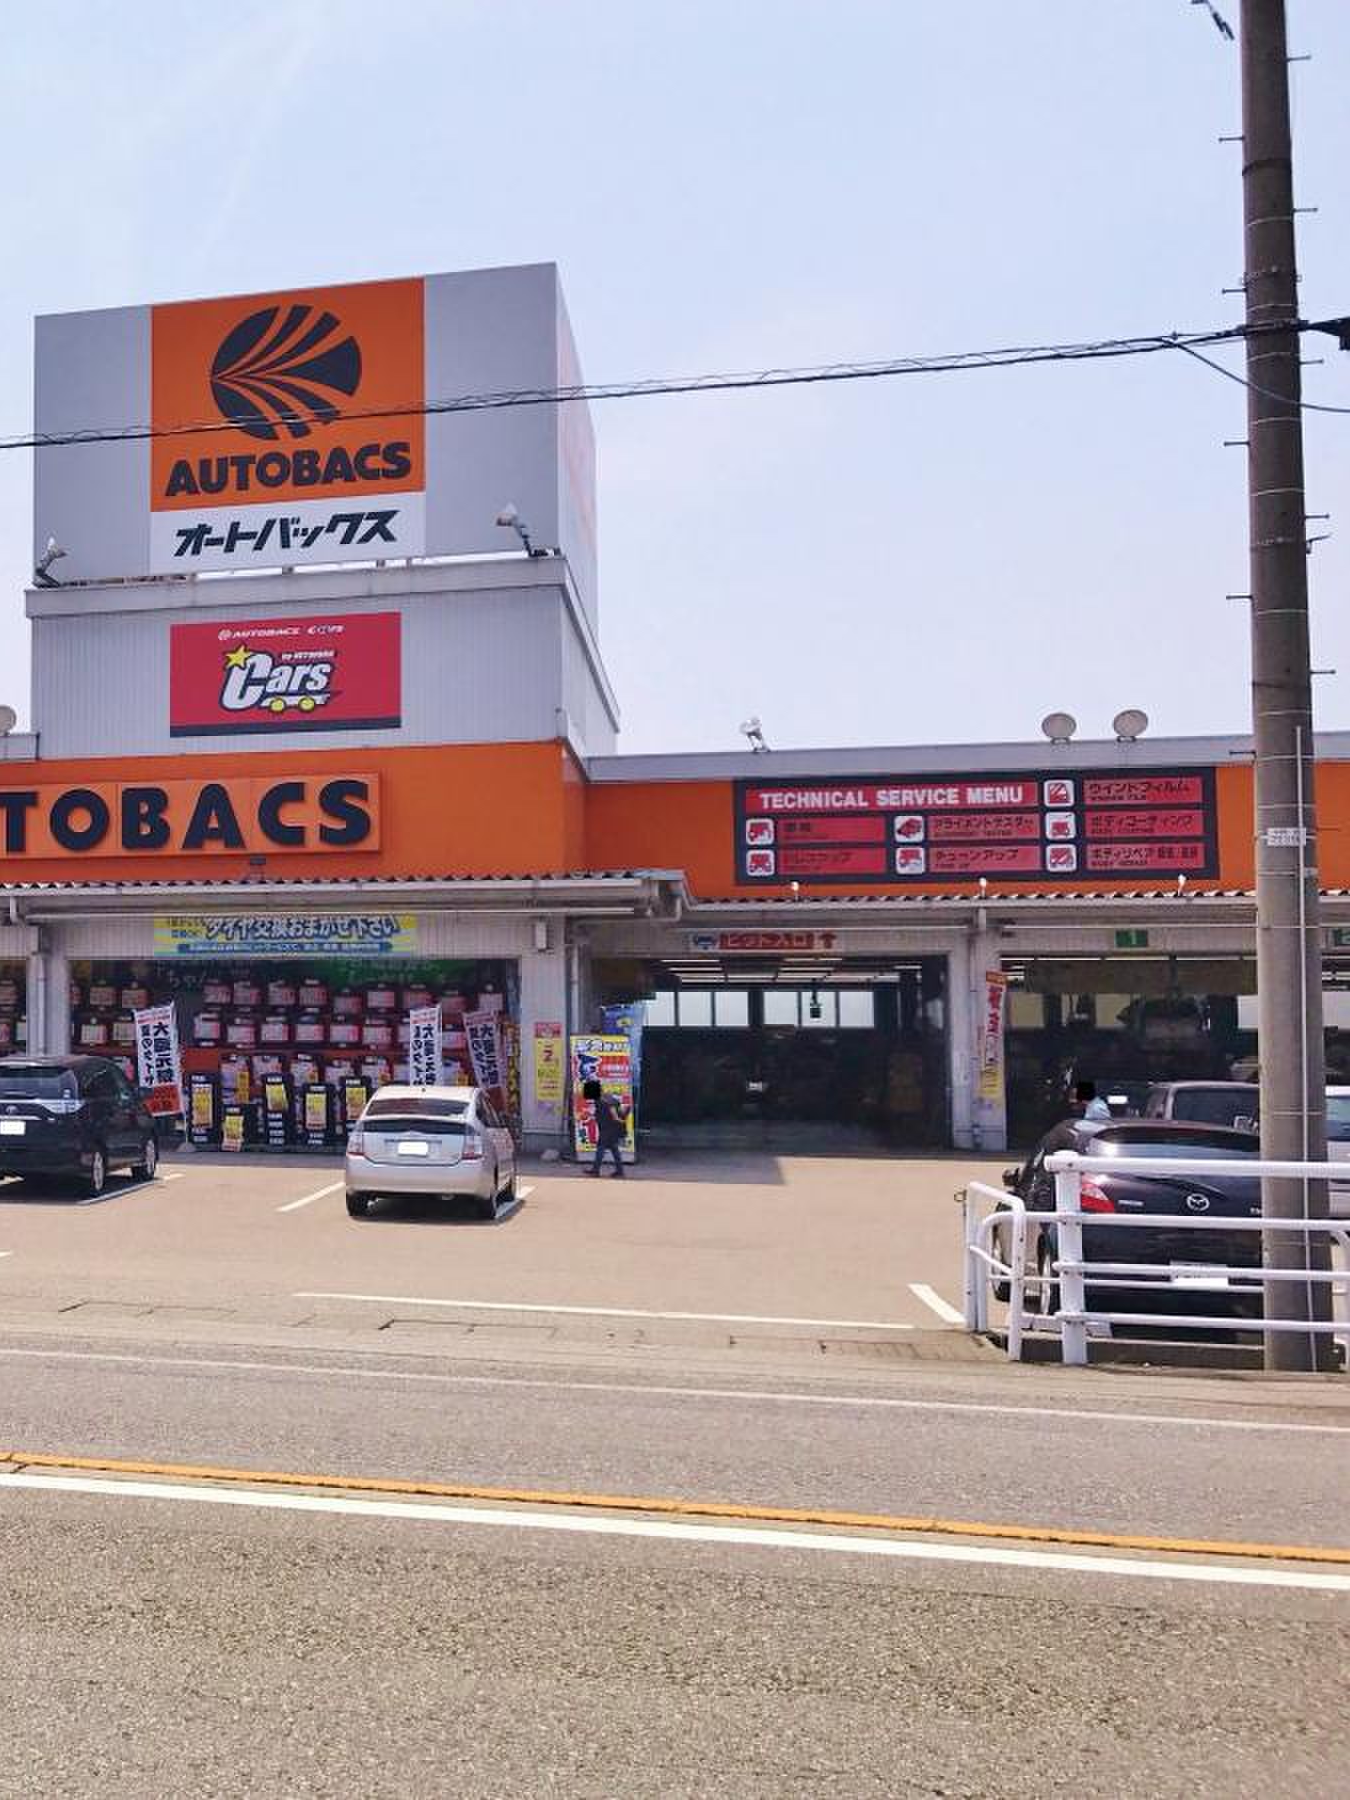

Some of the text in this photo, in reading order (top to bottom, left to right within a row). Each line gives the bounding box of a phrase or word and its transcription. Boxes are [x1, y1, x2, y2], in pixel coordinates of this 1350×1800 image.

[165, 442, 411, 497] AUTOBACS
[173, 510, 401, 557] オートバックス
[222, 653, 331, 710] Cars
[760, 785, 1023, 810] TECHNICAL SERVICE MENU
